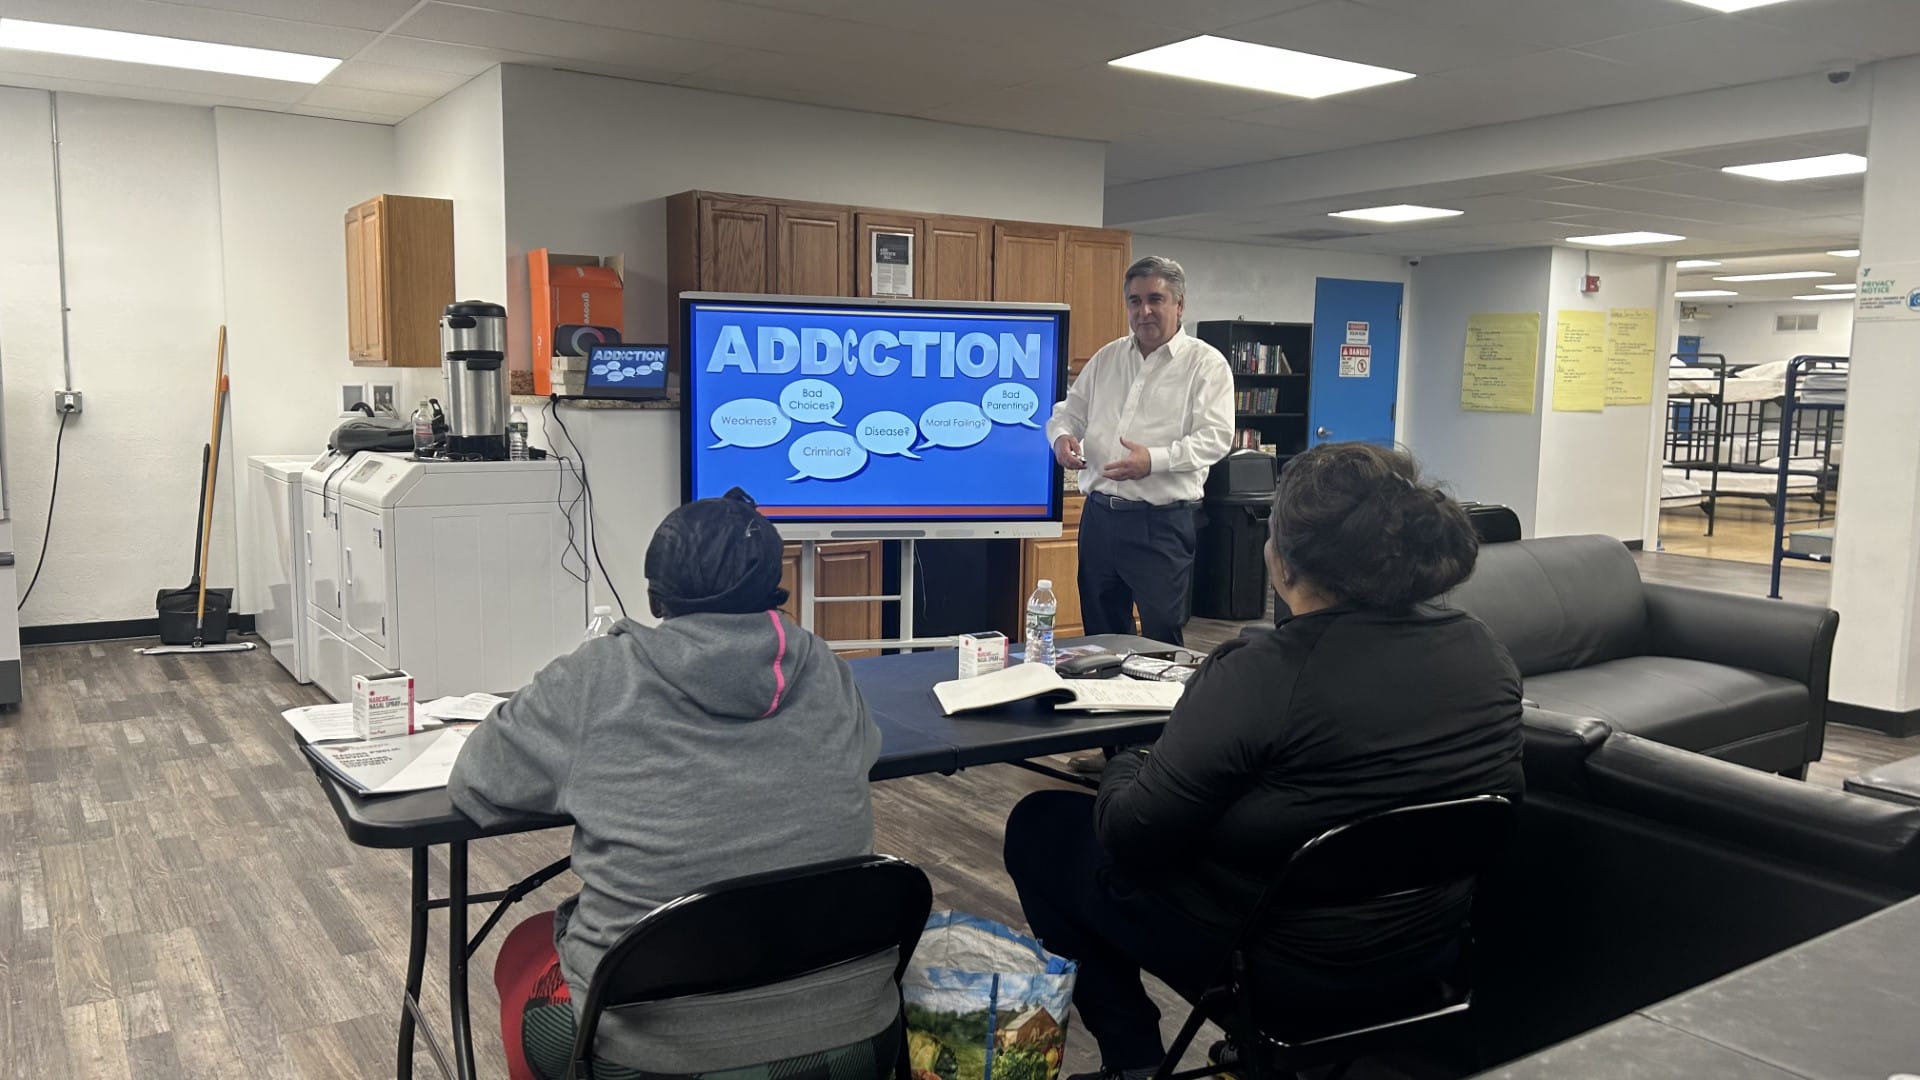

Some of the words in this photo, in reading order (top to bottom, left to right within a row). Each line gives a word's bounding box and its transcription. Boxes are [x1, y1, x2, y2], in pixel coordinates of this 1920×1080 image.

[803, 388, 822, 398] Bad
[1002, 390, 1020, 399] Bad
[789, 400, 835, 410] Choices?
[987, 401, 1034, 412] Parenting?
[721, 415, 777, 426] Weakness?
[926, 419, 951, 427] Moral
[865, 426, 910, 437] Disease?
[803, 447, 851, 457] Criminal?
